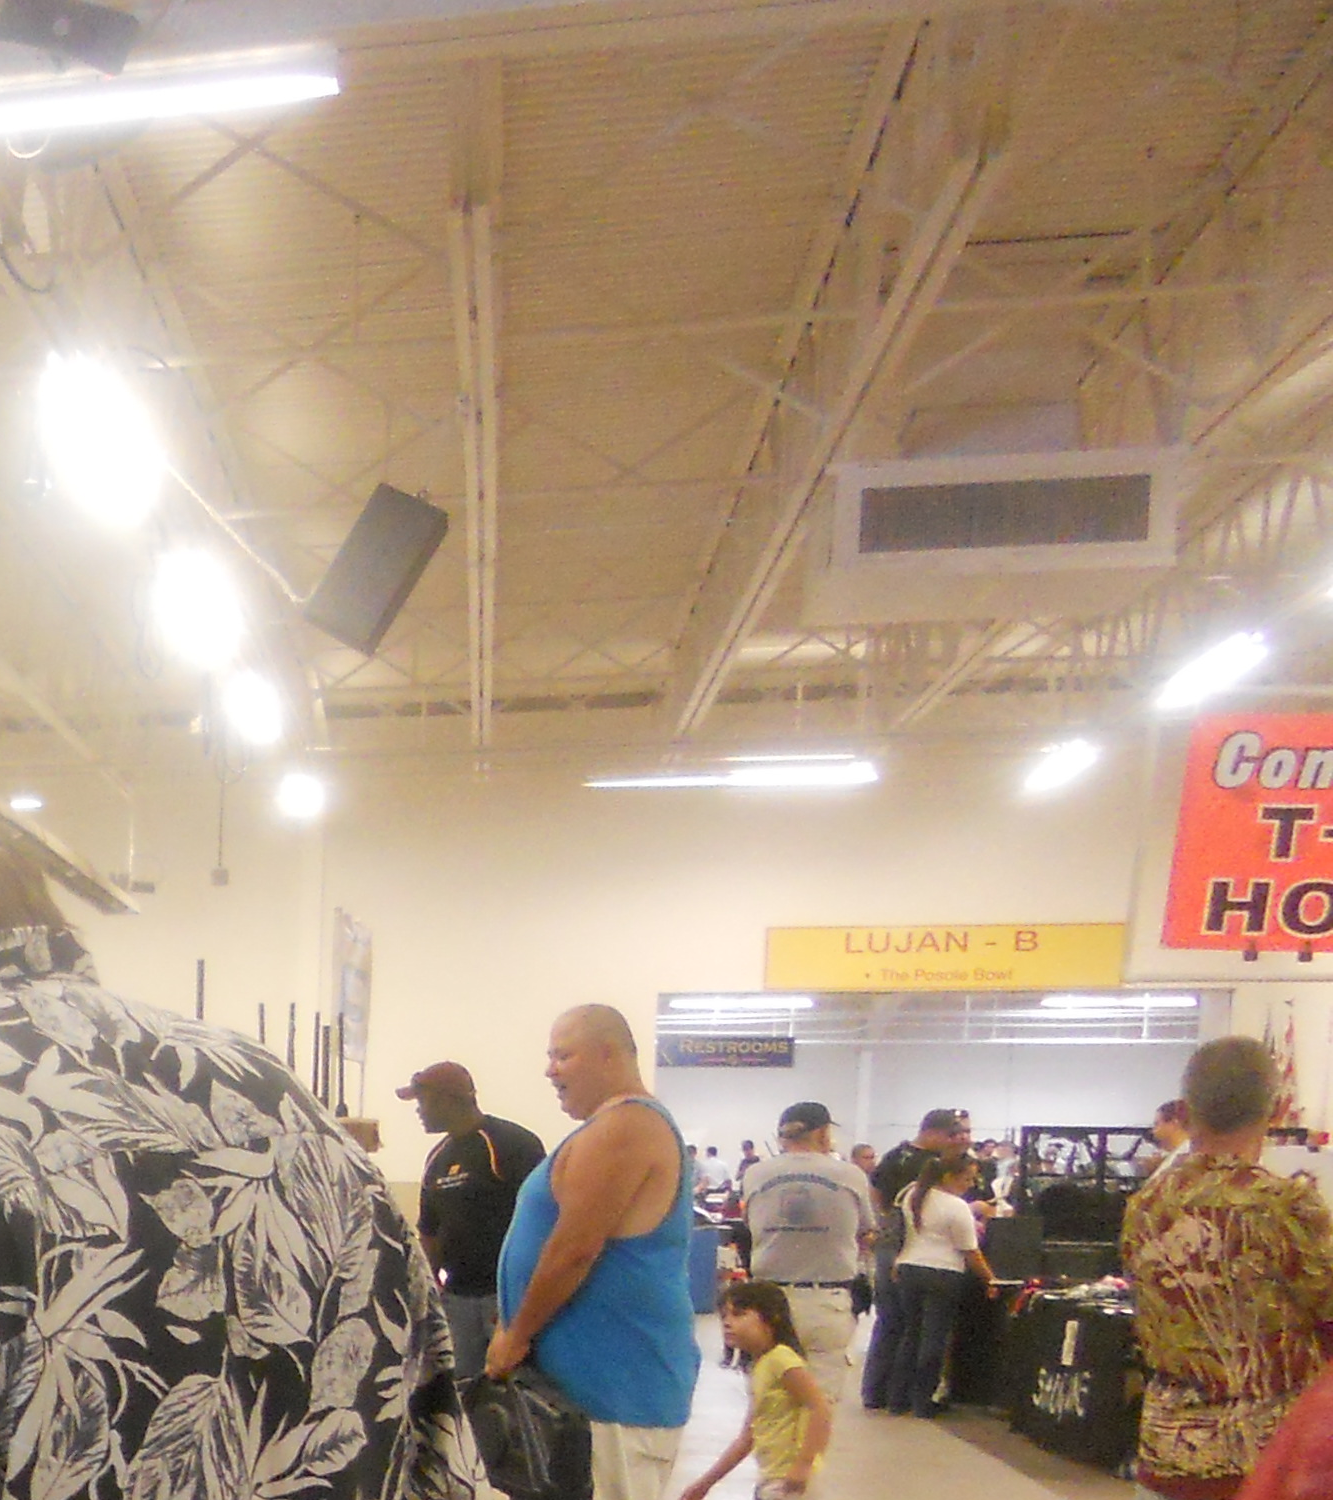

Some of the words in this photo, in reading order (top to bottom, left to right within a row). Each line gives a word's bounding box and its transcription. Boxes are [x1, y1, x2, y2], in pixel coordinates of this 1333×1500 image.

[1201, 878, 1333, 938] HO
[844, 930, 969, 954] LUJAN
[1014, 930, 1039, 952] B
[881, 967, 910, 982] The
[914, 967, 969, 982] Posole
[973, 966, 1014, 982] Bowl
[680, 1039, 789, 1054] RESTROOMS
